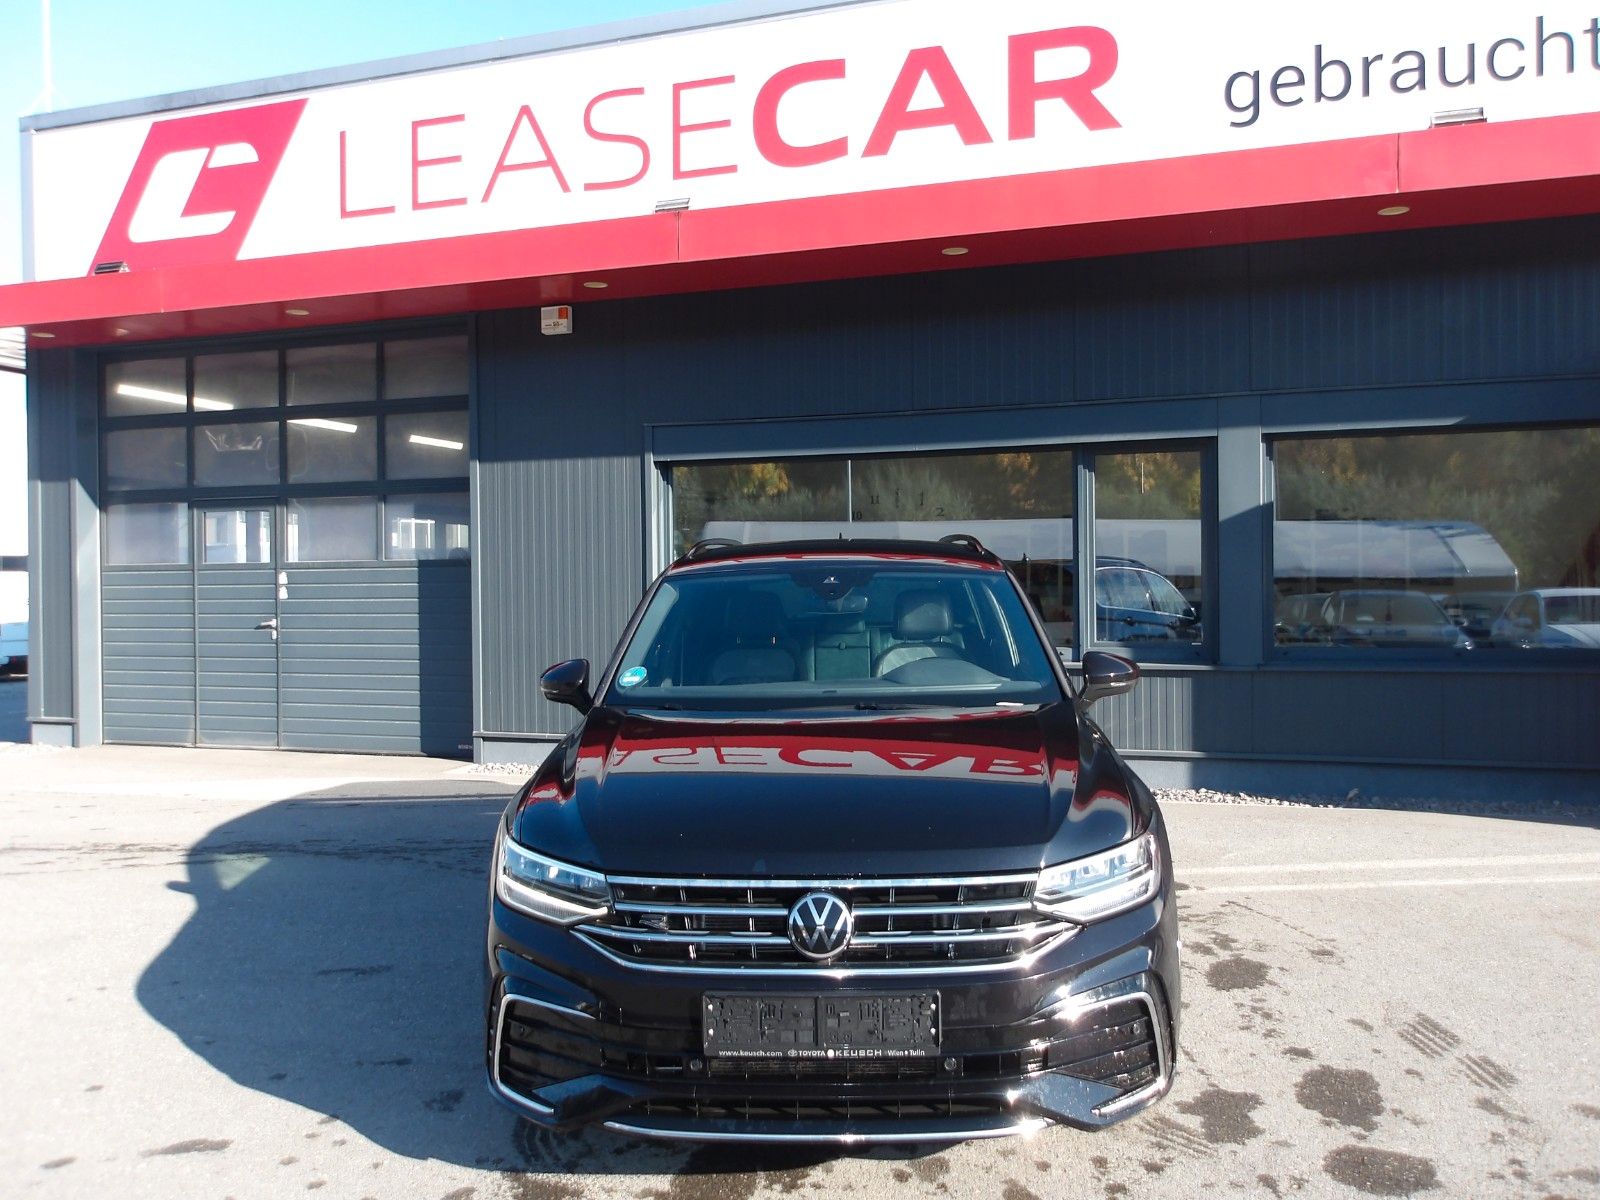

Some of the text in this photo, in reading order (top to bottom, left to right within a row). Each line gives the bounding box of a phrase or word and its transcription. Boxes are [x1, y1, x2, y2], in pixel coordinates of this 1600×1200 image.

[340, 25, 1121, 218] LEASECAR
[1225, 15, 1600, 128] gebraucht
[835, 1049, 882, 1057] KEUSCH
